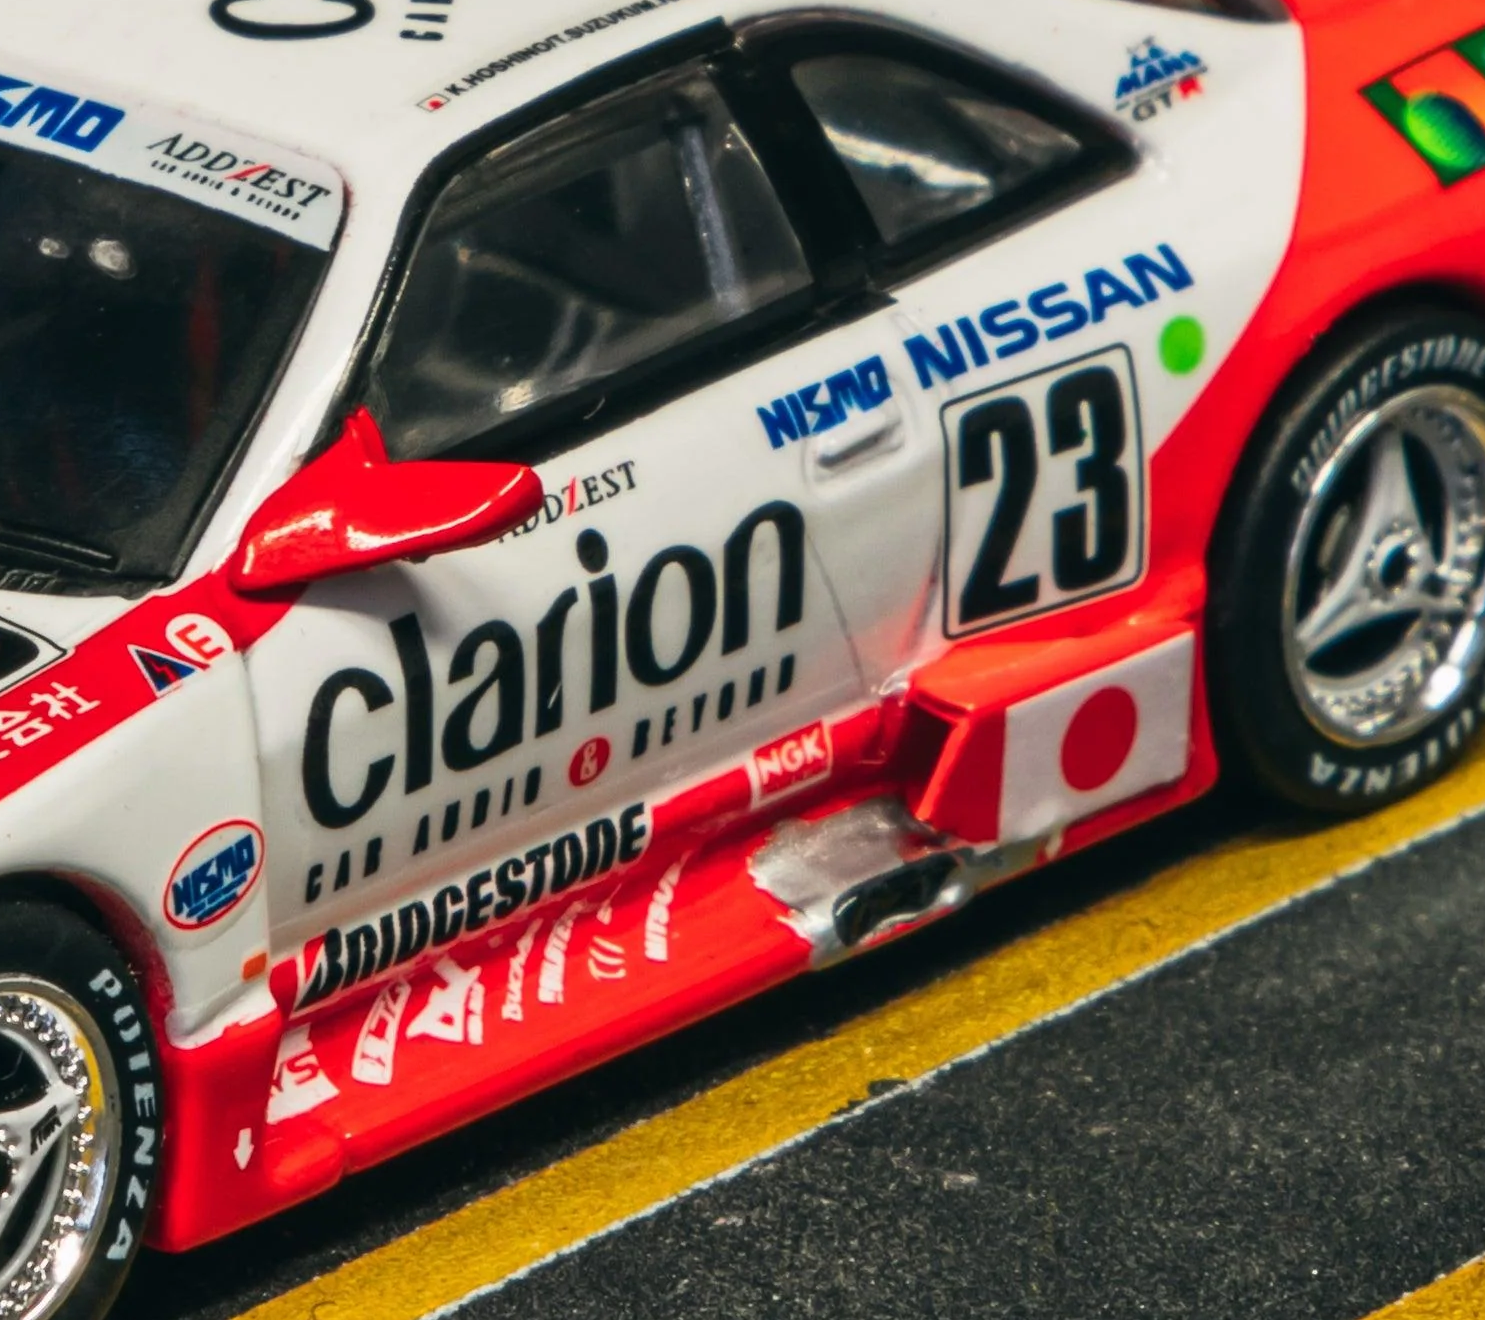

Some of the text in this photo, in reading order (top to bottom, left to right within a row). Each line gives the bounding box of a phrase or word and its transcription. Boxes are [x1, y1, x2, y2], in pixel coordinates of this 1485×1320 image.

[146, 133, 331, 207] ADDZEST
[756, 243, 1195, 449] NISMO NISSAN
[958, 365, 1129, 624] 23
[175, 623, 225, 661] E
[304, 837, 383, 904] CAR
[412, 766, 542, 856] AUDIO
[632, 653, 795, 759] BEYOND
[756, 726, 826, 785] NGK
[293, 802, 648, 1012] BRIDGESTONE
[89, 967, 157, 1261] POTENZA
